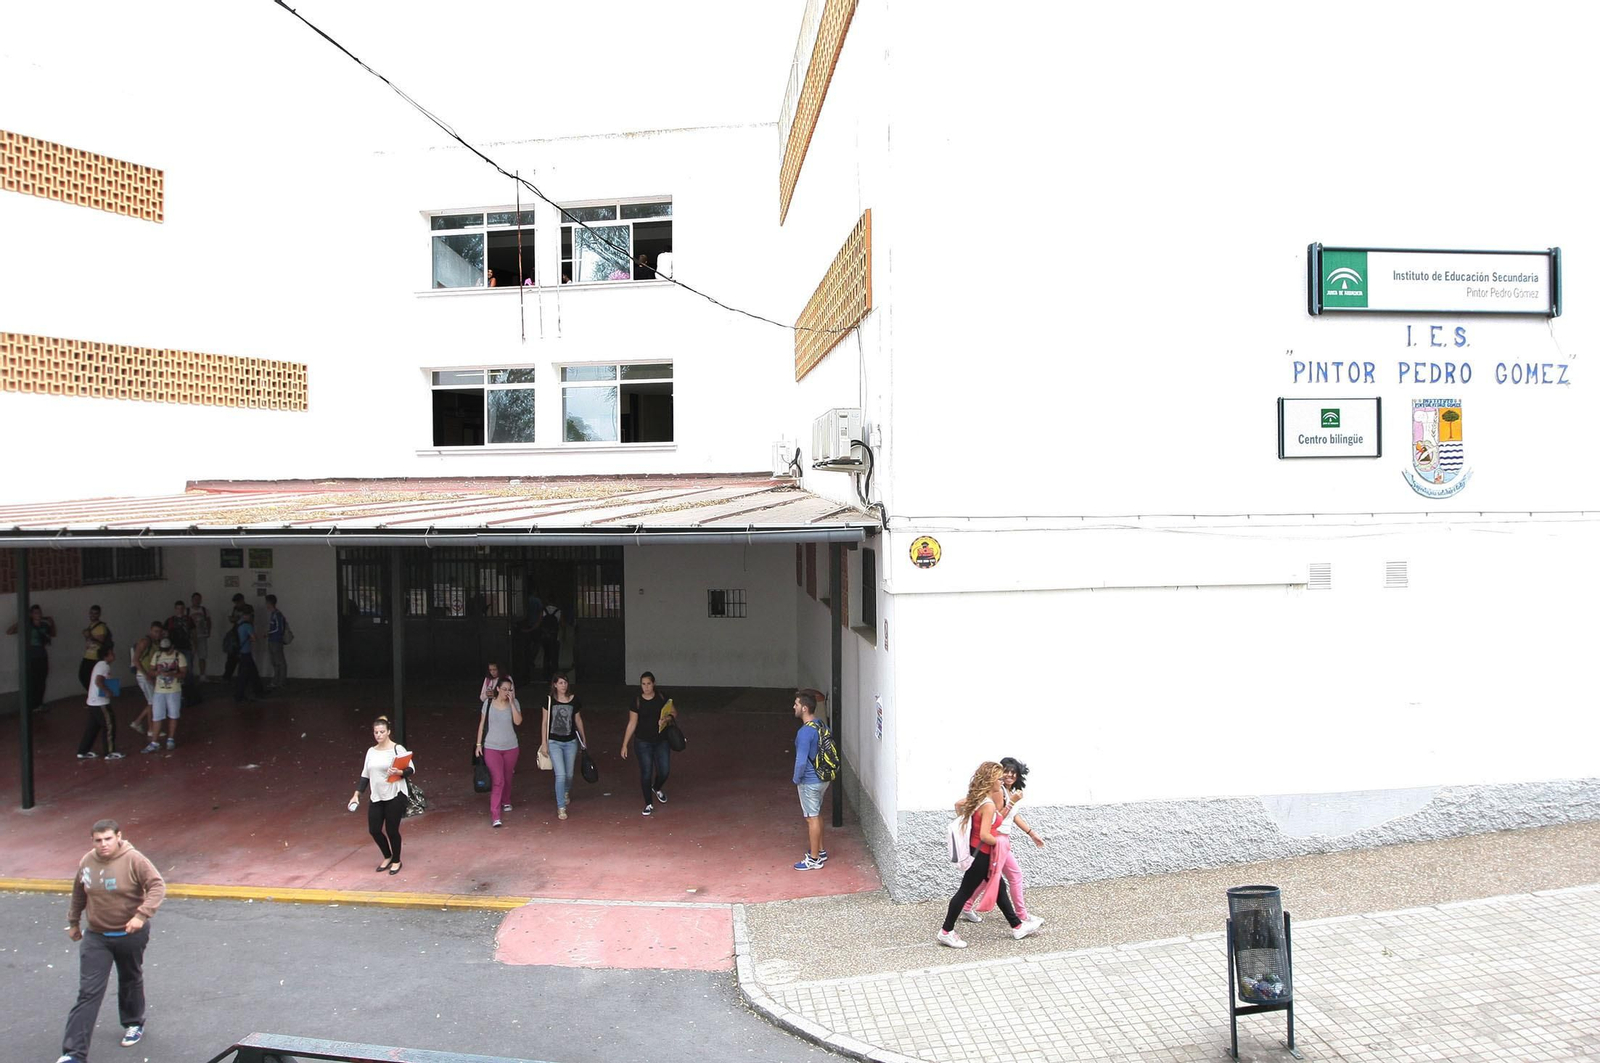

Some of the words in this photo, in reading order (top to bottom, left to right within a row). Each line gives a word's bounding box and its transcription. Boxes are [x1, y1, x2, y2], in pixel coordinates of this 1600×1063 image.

[1393, 270, 1430, 281] Instituto
[1431, 271, 1442, 281] de
[1444, 271, 1490, 283] Educación
[1492, 272, 1539, 283] Secundaria
[1466, 287, 1489, 298] Pintor
[1490, 287, 1512, 298] Pedro
[1397, 361, 1473, 385] PEDRO
[1297, 433, 1328, 445] Centro
[1329, 433, 1364, 447] bilingüe
